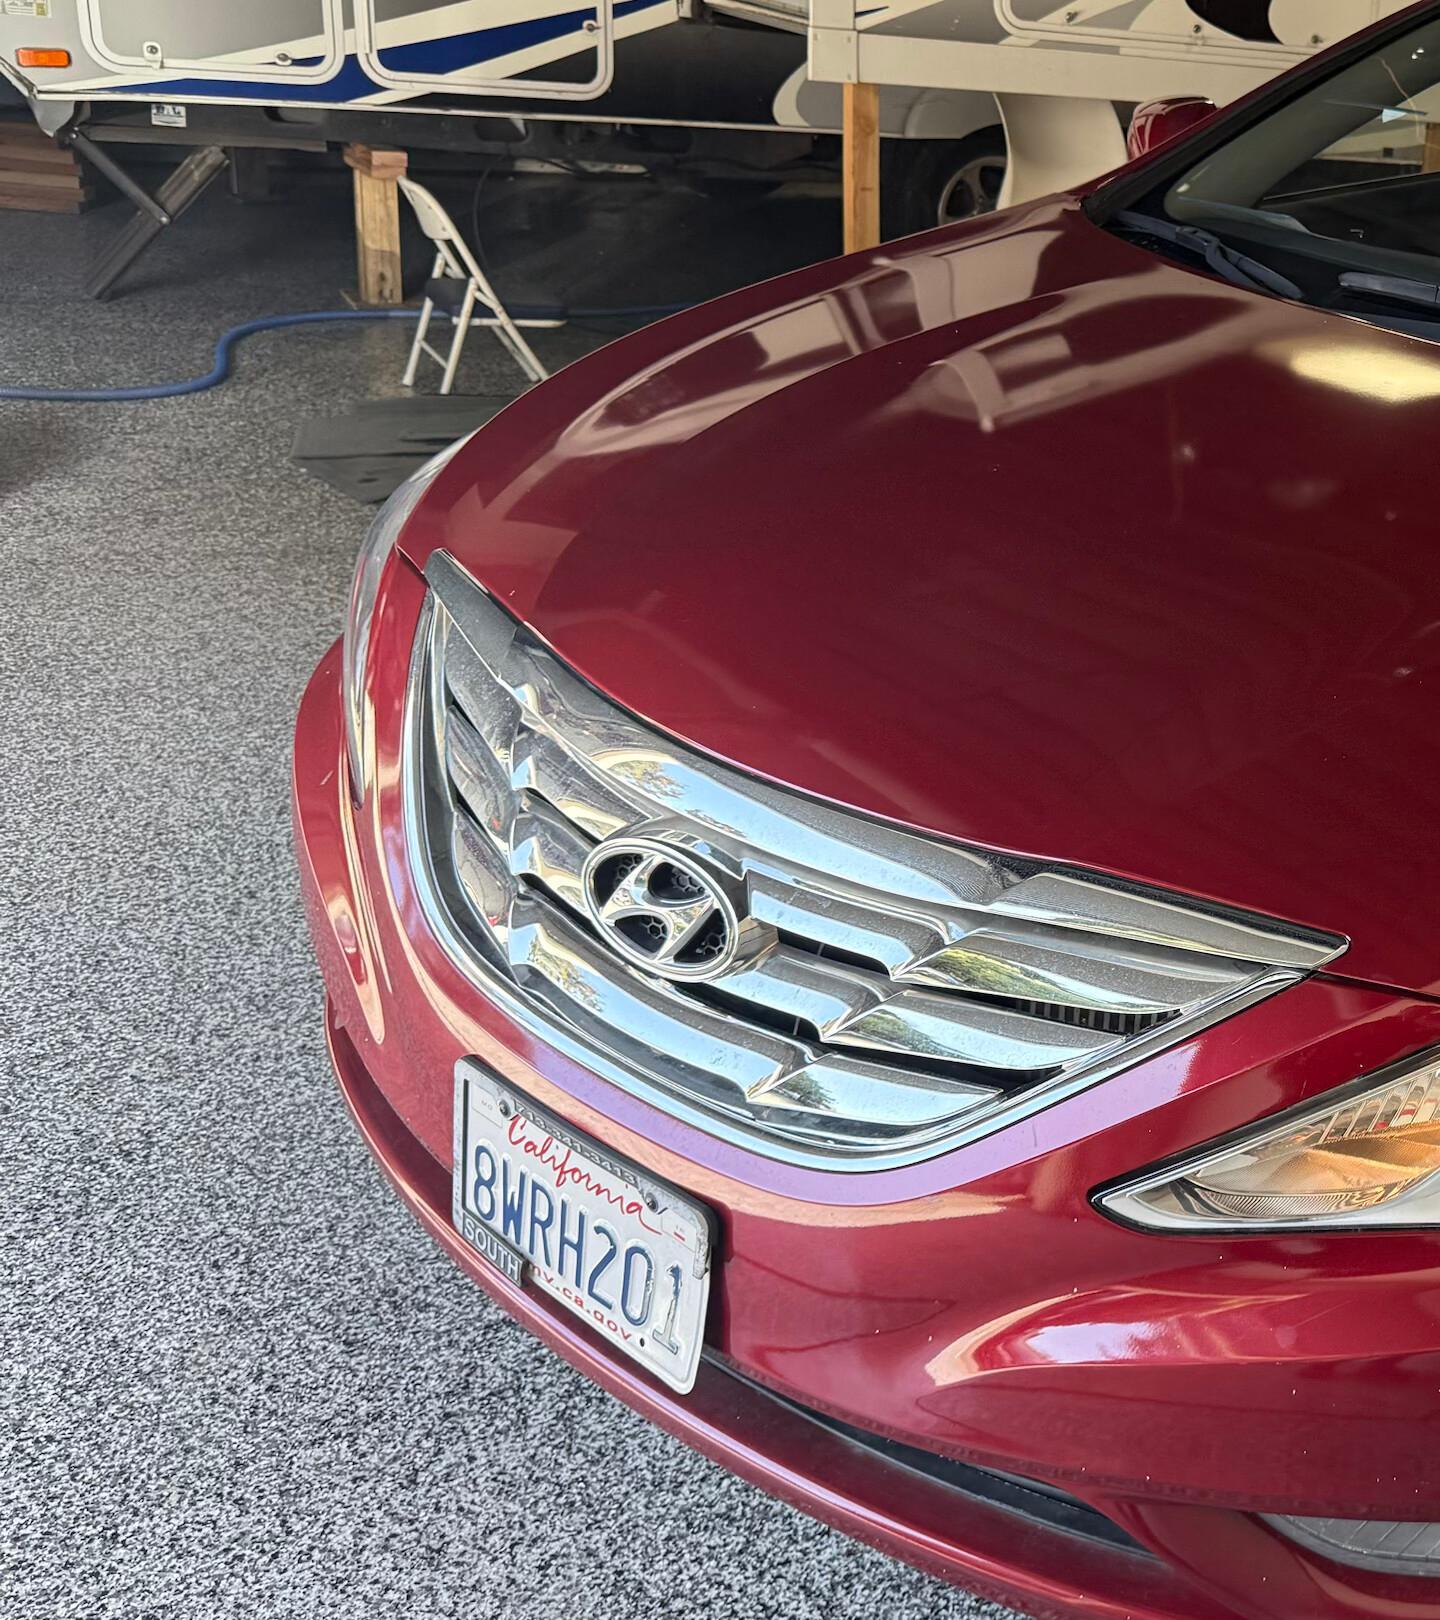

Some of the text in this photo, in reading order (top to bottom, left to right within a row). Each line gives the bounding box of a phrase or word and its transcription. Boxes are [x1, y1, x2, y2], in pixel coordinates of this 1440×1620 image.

[508, 1114, 662, 1236] California
[464, 1220, 520, 1281] SOUTH
[474, 1144, 683, 1356] 8WRH201
